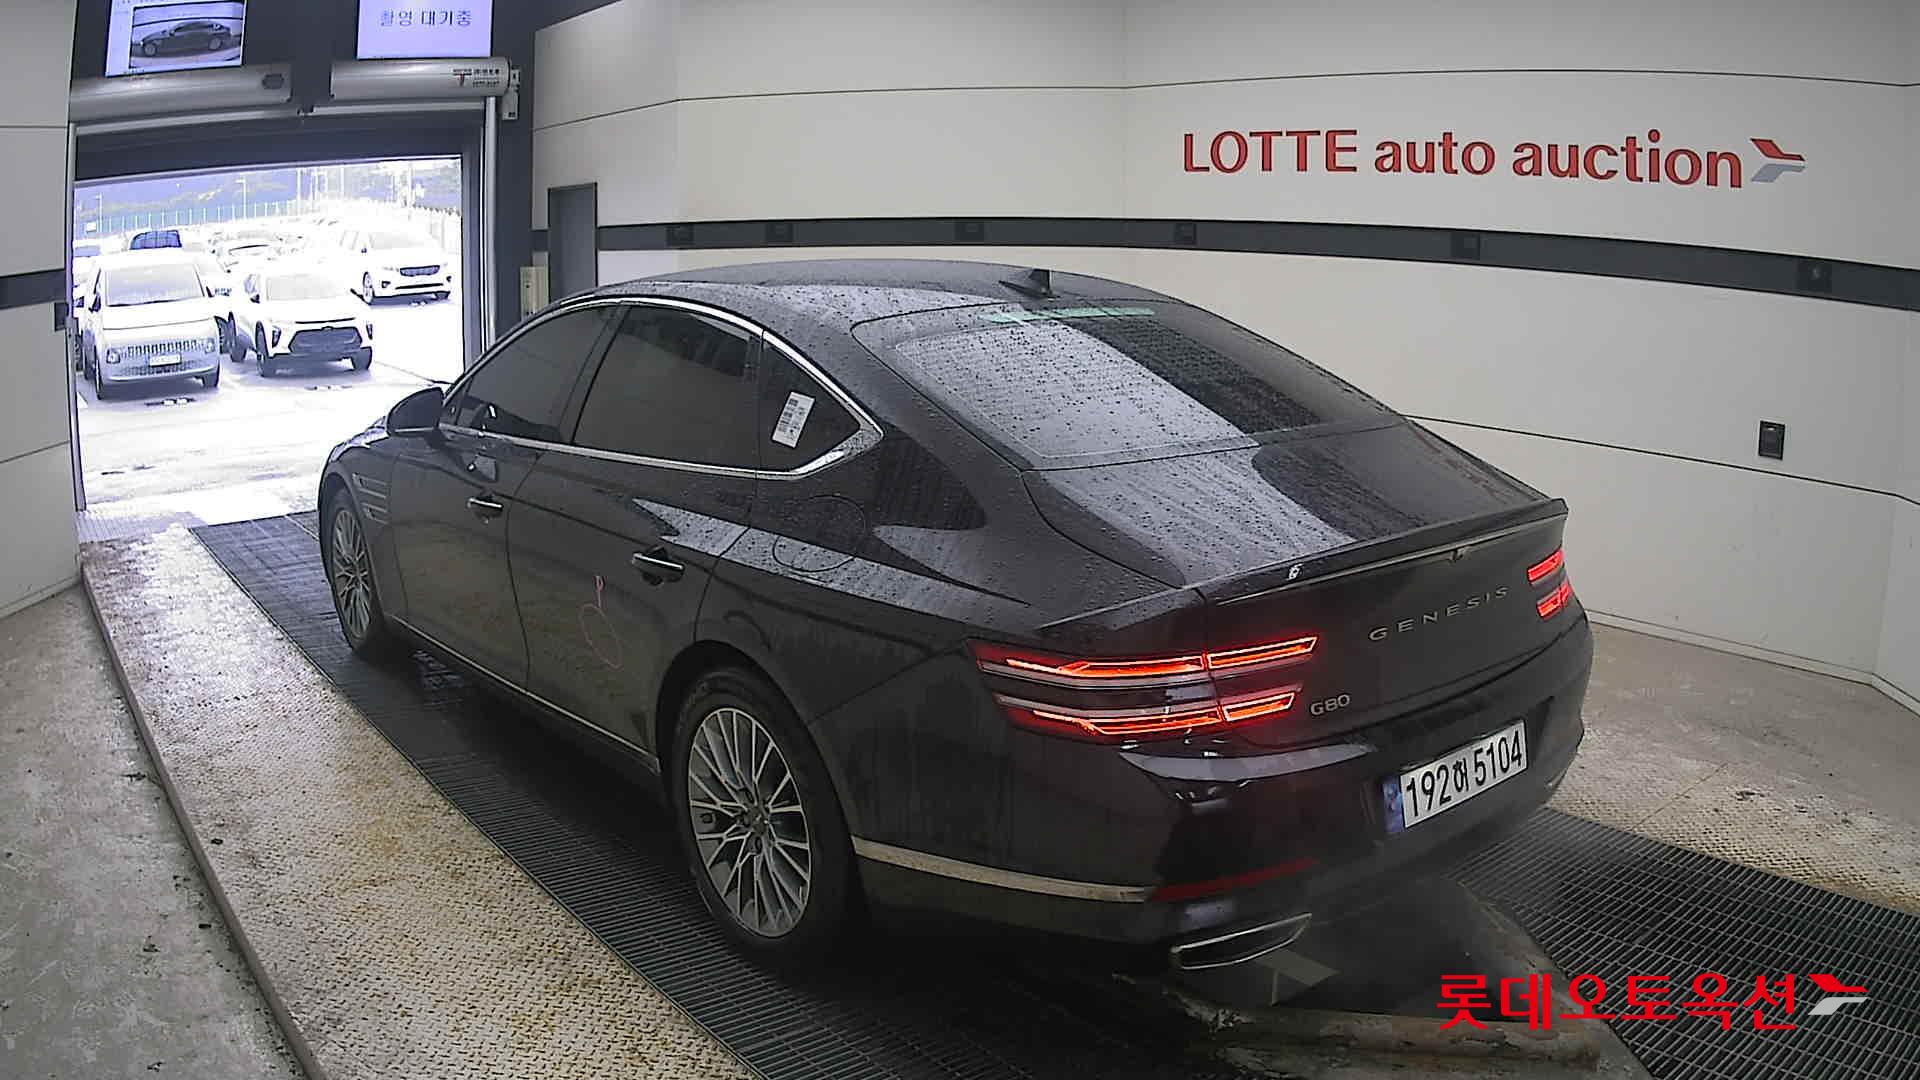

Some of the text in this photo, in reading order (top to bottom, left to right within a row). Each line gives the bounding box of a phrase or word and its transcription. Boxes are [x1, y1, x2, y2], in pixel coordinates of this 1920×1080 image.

[421, 10, 472, 26] 대기중
[1183, 128, 1743, 189] LOTTE auto auction
[1369, 587, 1507, 640] GENESIS
[1309, 694, 1351, 716] G80
[1406, 729, 1523, 818] 192허 5104
